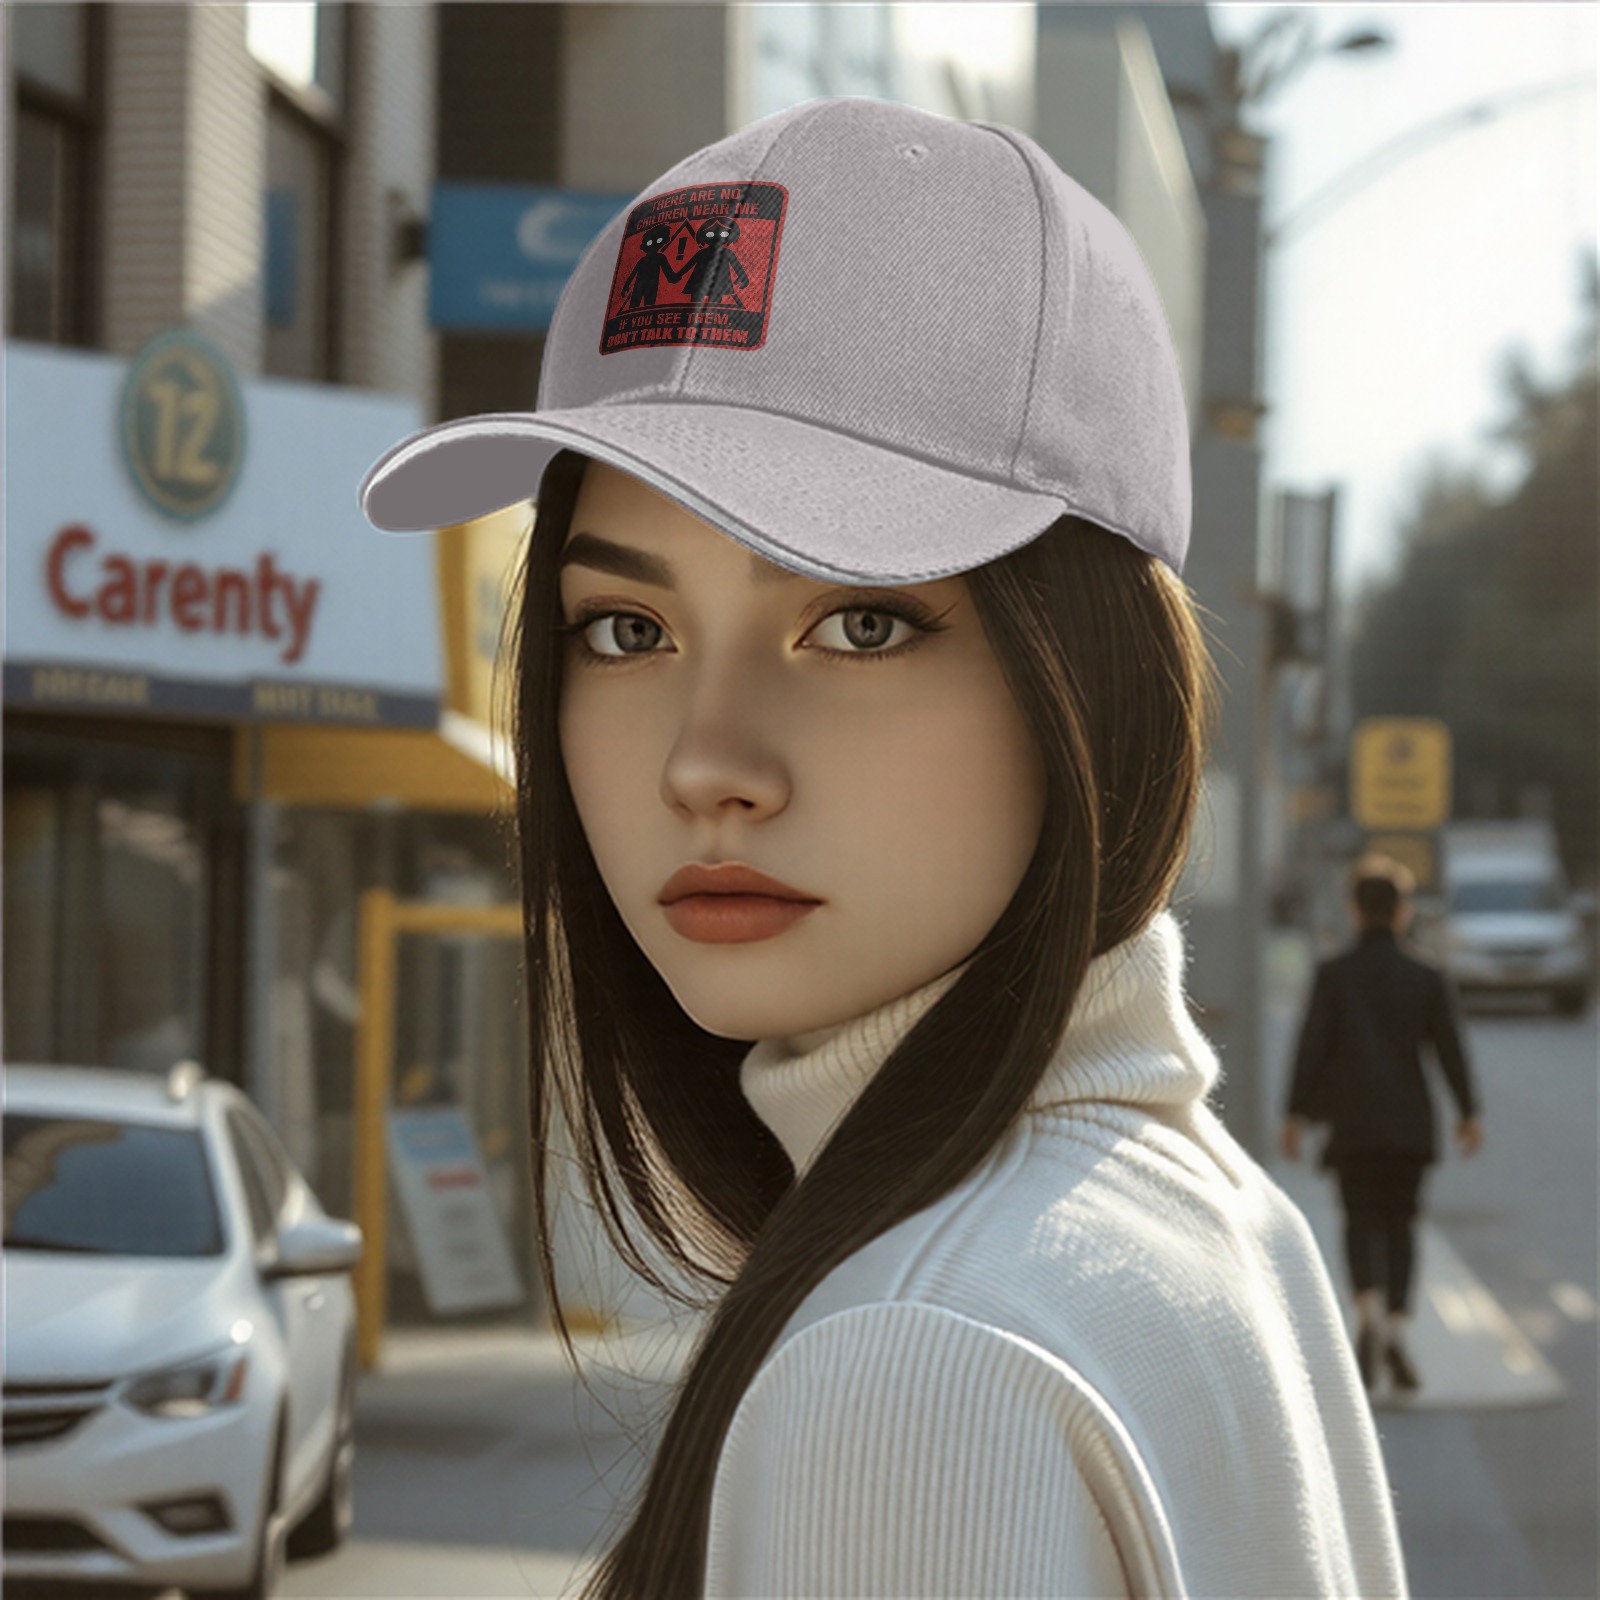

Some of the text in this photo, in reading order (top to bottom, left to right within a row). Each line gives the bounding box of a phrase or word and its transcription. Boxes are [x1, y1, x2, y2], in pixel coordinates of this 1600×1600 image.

[652, 187, 741, 212] THERE ARE NO
[636, 202, 760, 231] CHILDREN NEAR ME
[619, 319, 628, 331] IF
[631, 314, 653, 327] YOU
[656, 312, 681, 325] SEE
[606, 326, 750, 348] DON'T TALK TO THEM
[146, 379, 220, 483] 12
[46, 523, 321, 664] Carenty
